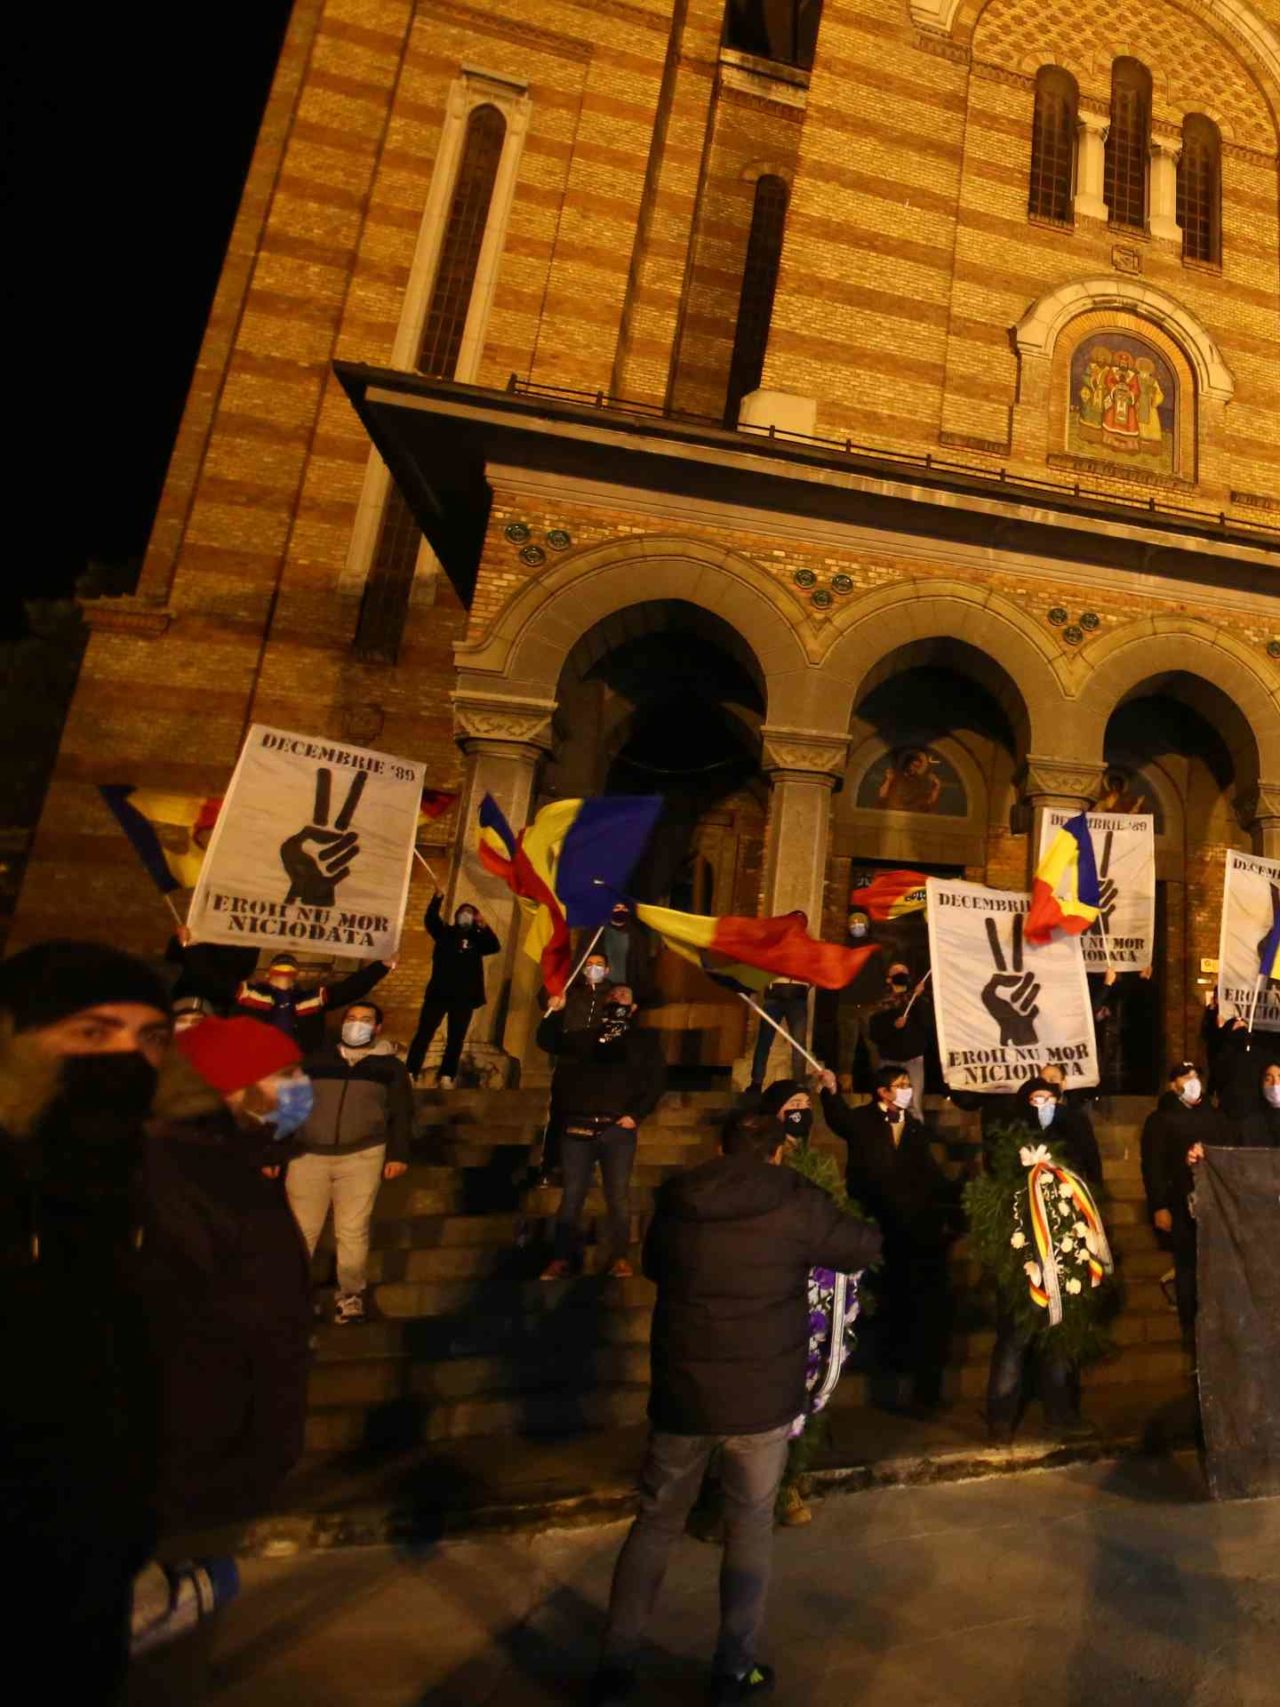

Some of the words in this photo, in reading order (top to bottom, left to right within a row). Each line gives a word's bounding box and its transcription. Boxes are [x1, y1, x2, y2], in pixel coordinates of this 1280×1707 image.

[261, 733, 384, 774] DECEMBRIE
[212, 894, 287, 917] EROII
[296, 907, 331, 924] NU
[337, 912, 390, 933] MOR
[228, 915, 376, 948] NICIODATA
[1113, 937, 1145, 950] MOR
[949, 1045, 1006, 1067] EROII
[1016, 1047, 1040, 1062] NU
[1046, 1043, 1089, 1063] MOR
[964, 1062, 1085, 1085] NICIODTA
